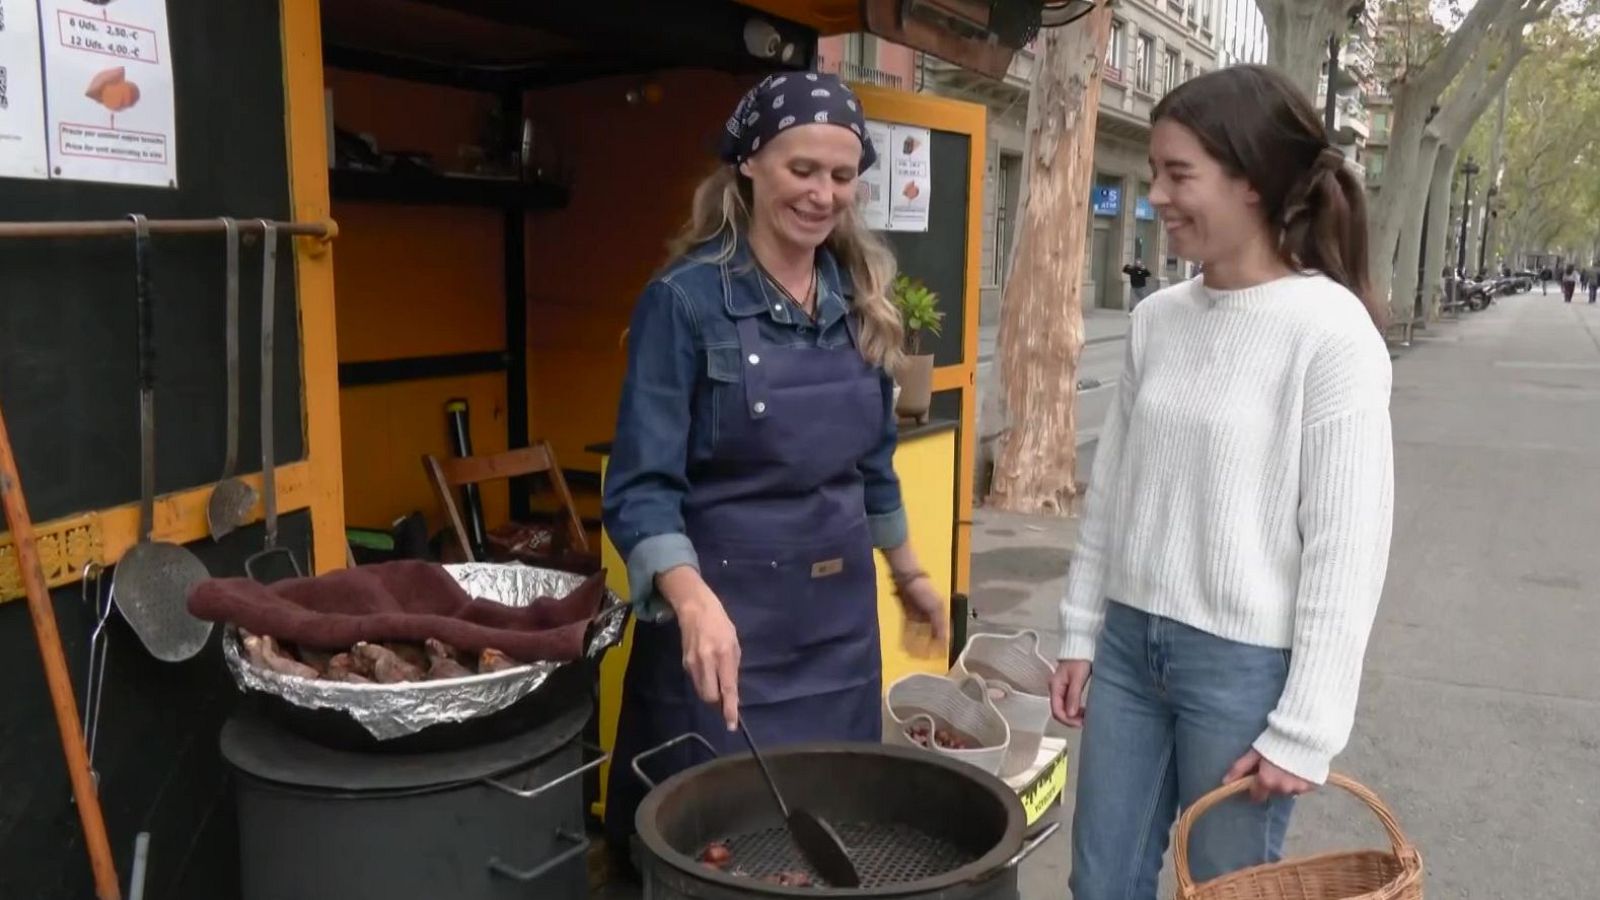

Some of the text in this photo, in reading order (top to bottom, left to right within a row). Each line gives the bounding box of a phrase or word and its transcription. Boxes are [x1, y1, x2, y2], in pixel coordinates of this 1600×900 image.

[69, 18, 76, 27] 6
[79, 19, 98, 31] Uds.
[70, 36, 82, 46] 12
[85, 38, 105, 50] Uds.
